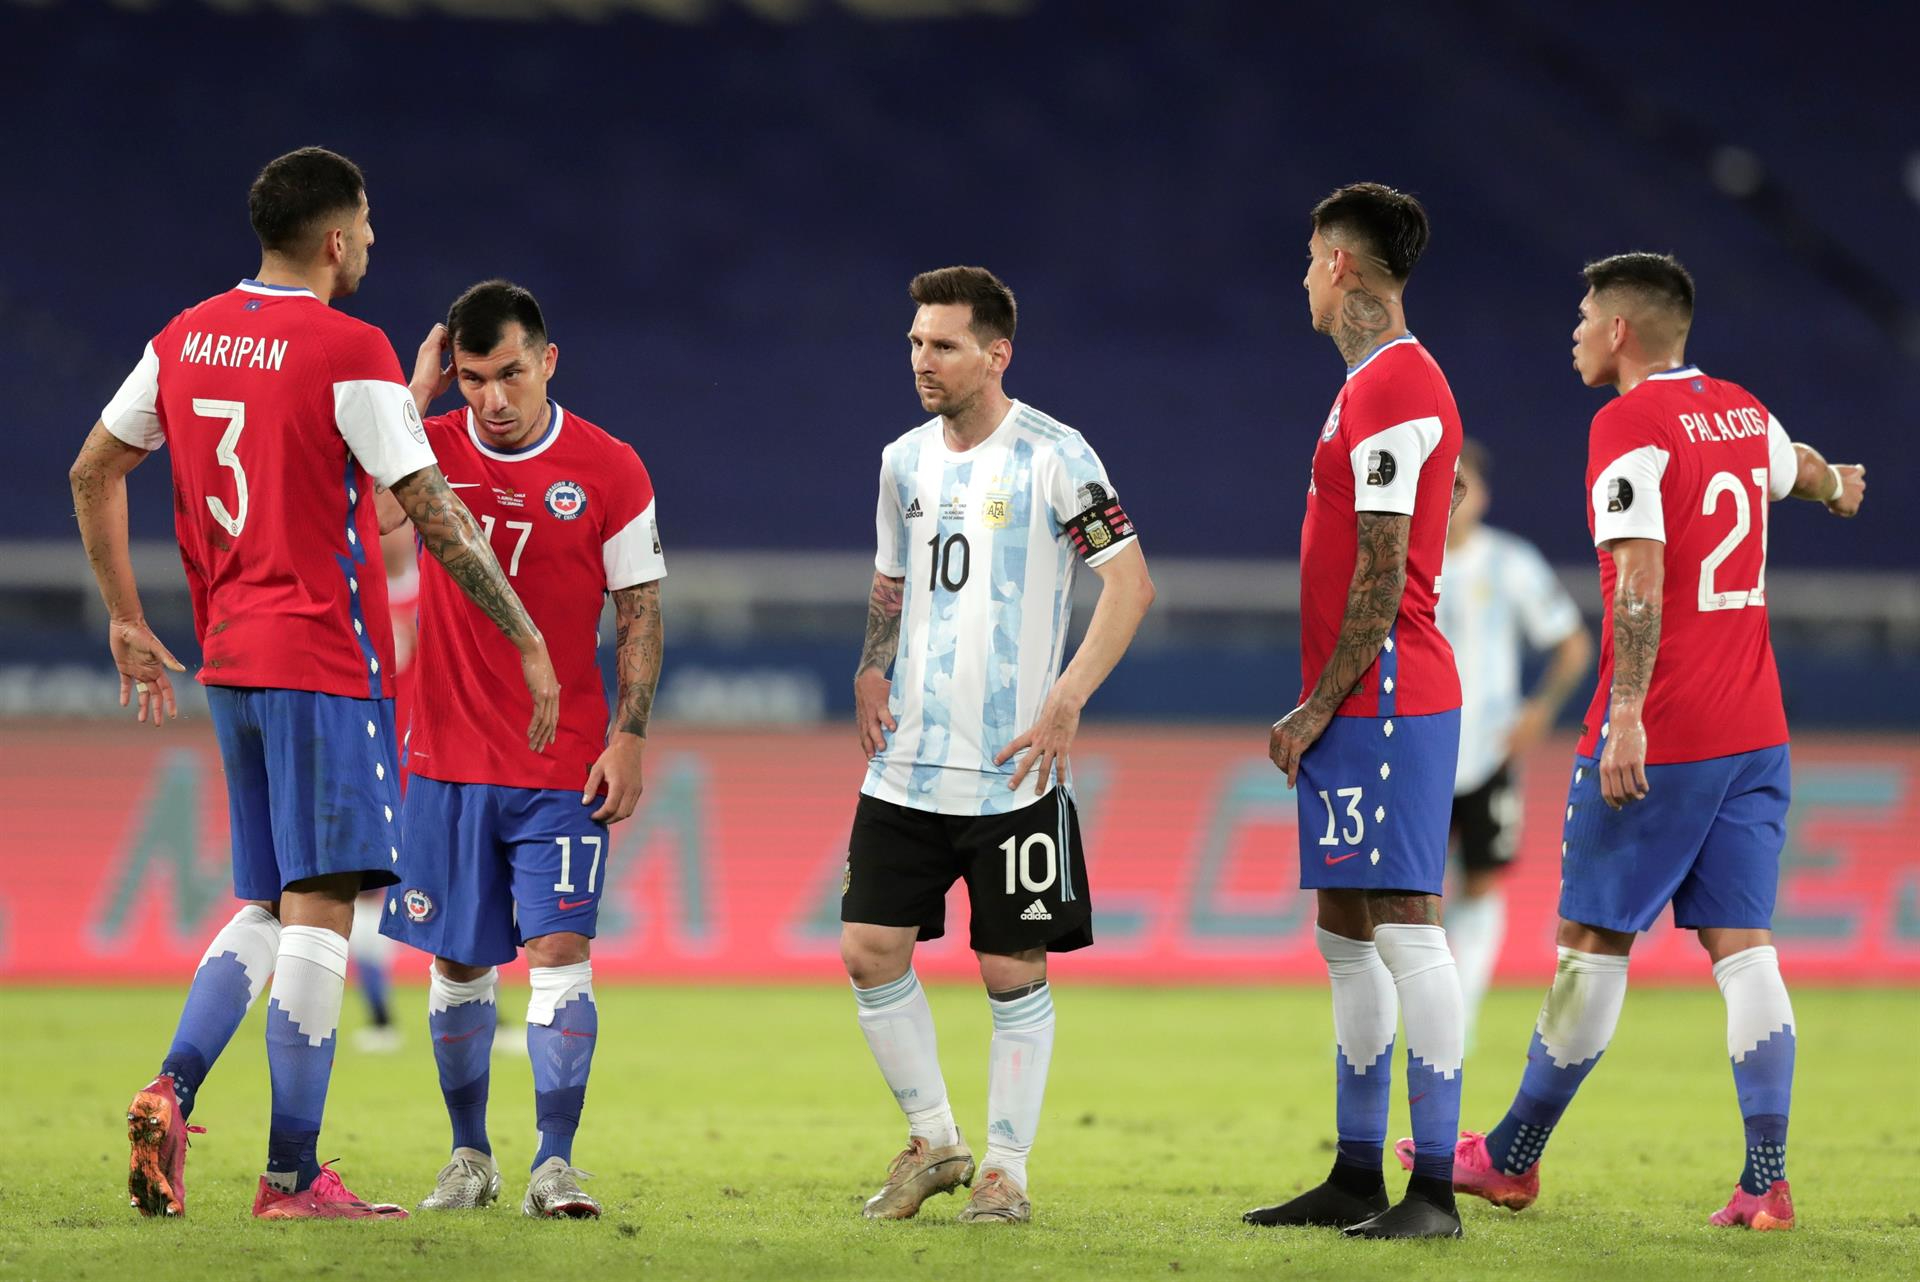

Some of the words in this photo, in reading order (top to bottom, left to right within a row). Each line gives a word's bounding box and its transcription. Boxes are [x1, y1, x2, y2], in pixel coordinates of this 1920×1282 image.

[180, 331, 288, 371] MARIPAN
[1679, 407, 1766, 443] PALACIOS
[192, 397, 249, 537] 3
[905, 511, 924, 520] adidas
[1697, 467, 1769, 612] 21
[927, 532, 970, 593] 10
[1318, 786, 1365, 846] 13
[553, 836, 602, 893] 17
[998, 832, 1057, 895] 10
